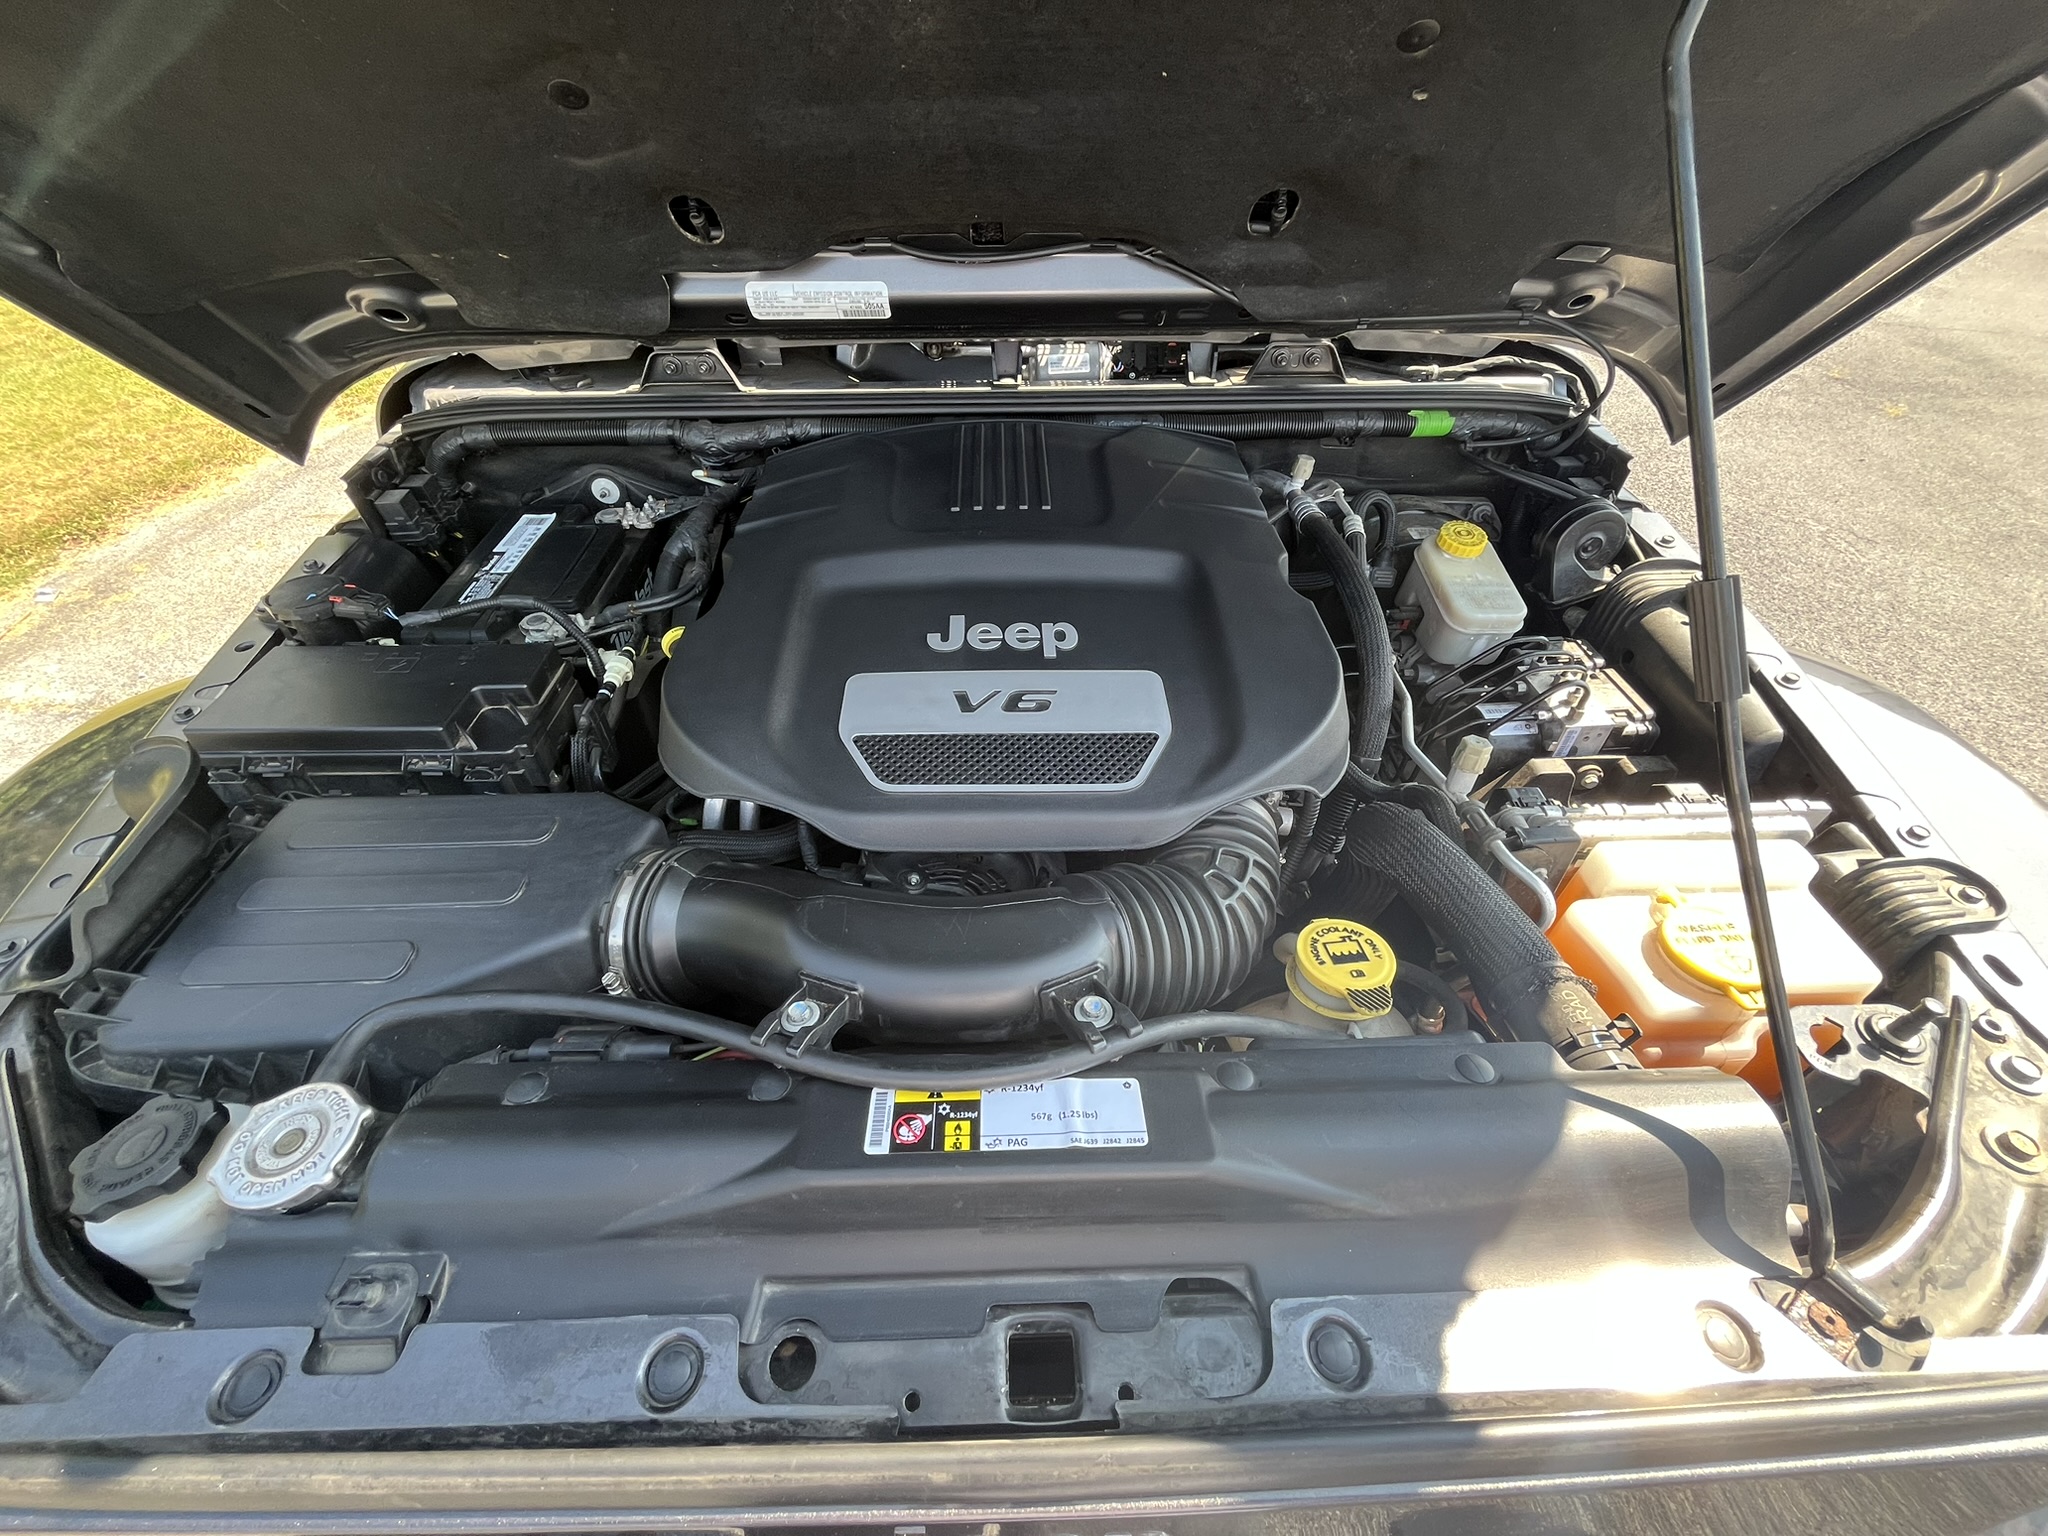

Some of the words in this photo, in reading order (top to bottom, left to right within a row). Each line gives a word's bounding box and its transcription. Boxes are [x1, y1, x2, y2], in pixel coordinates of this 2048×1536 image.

[926, 614, 1079, 659] Jeep
[952, 689, 1058, 713] V6
[1315, 925, 1365, 938] COOLANT
[1309, 936, 1327, 966] ENGINE
[1364, 938, 1383, 960] ONLY
[277, 1088, 328, 1111] KEEP
[324, 1090, 350, 1122] TIGHT
[949, 1111, 978, 1119] R-1234yf
[1031, 1112, 1053, 1121] 567g
[1058, 1110, 1081, 1121] (1.25
[1082, 1110, 1098, 1120] lbs)
[1007, 1138, 1028, 1147] PAG
[1103, 1137, 1121, 1145] J2842
[238, 1177, 287, 1196] OPEN
